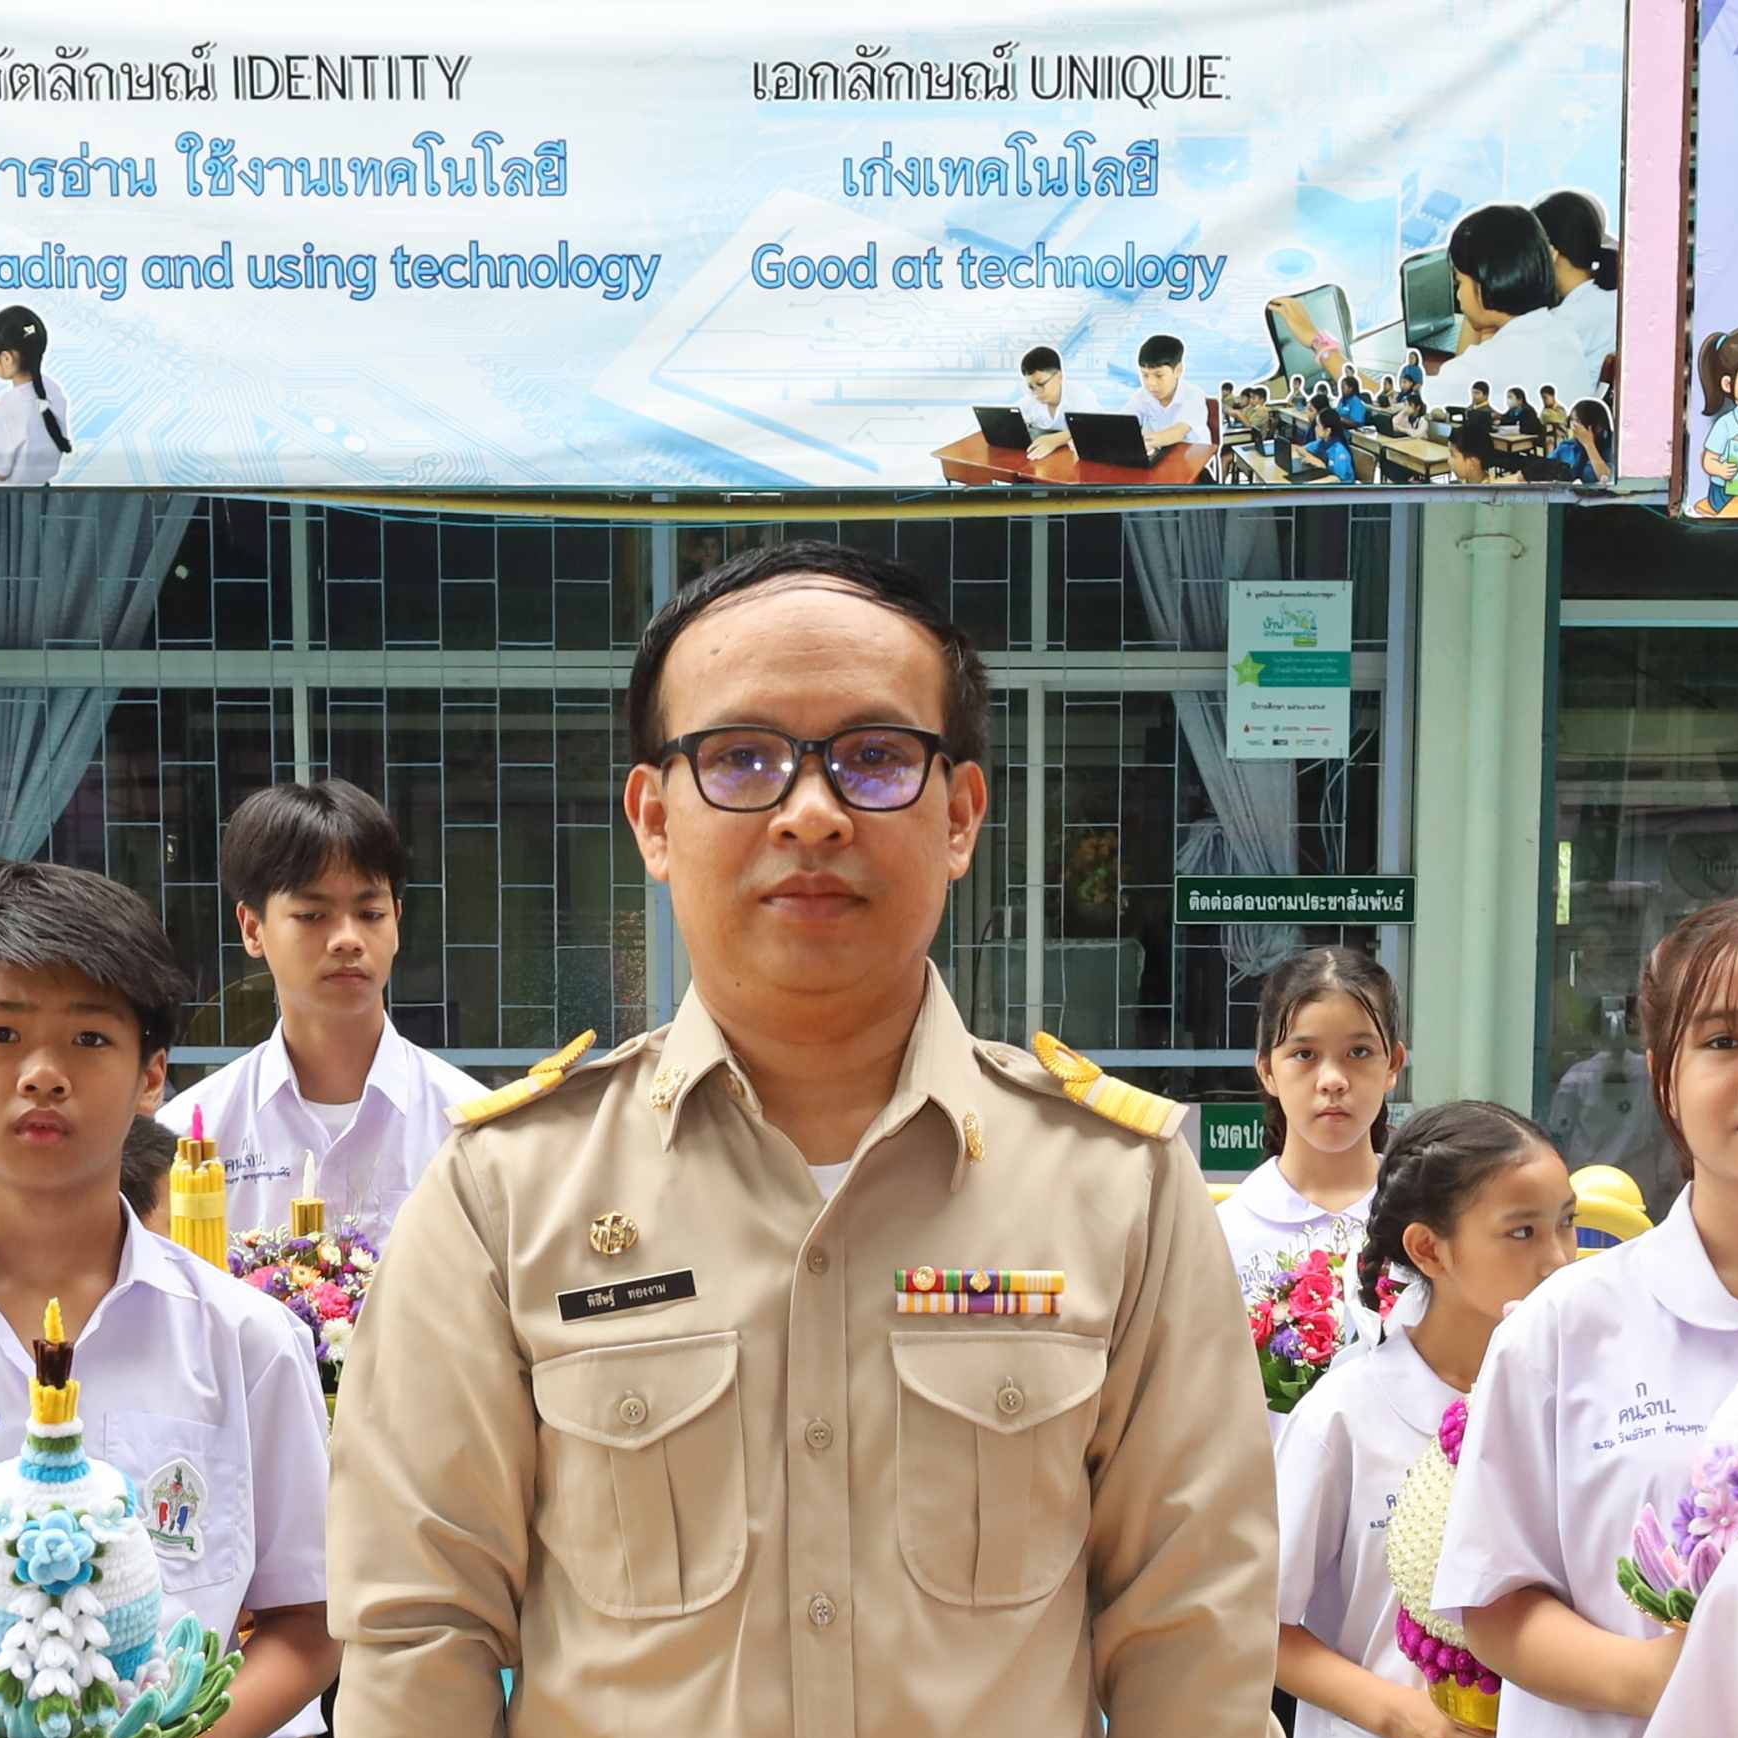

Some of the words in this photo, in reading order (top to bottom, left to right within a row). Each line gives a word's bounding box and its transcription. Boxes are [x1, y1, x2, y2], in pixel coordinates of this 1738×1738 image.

[232, 54, 471, 102] IDENTITY
[751, 42, 1020, 102] เอกลักษณ์
[1029, 54, 1231, 110] UNIQUE
[176, 131, 569, 198] ใช้งานเทคโนโลยี
[842, 131, 1160, 198] เก่งเทคโนโลยี
[142, 242, 233, 290] and
[246, 243, 377, 301] using
[391, 241, 662, 301] technology
[751, 242, 879, 290] Good
[892, 247, 944, 290] at
[957, 242, 1228, 301] technology
